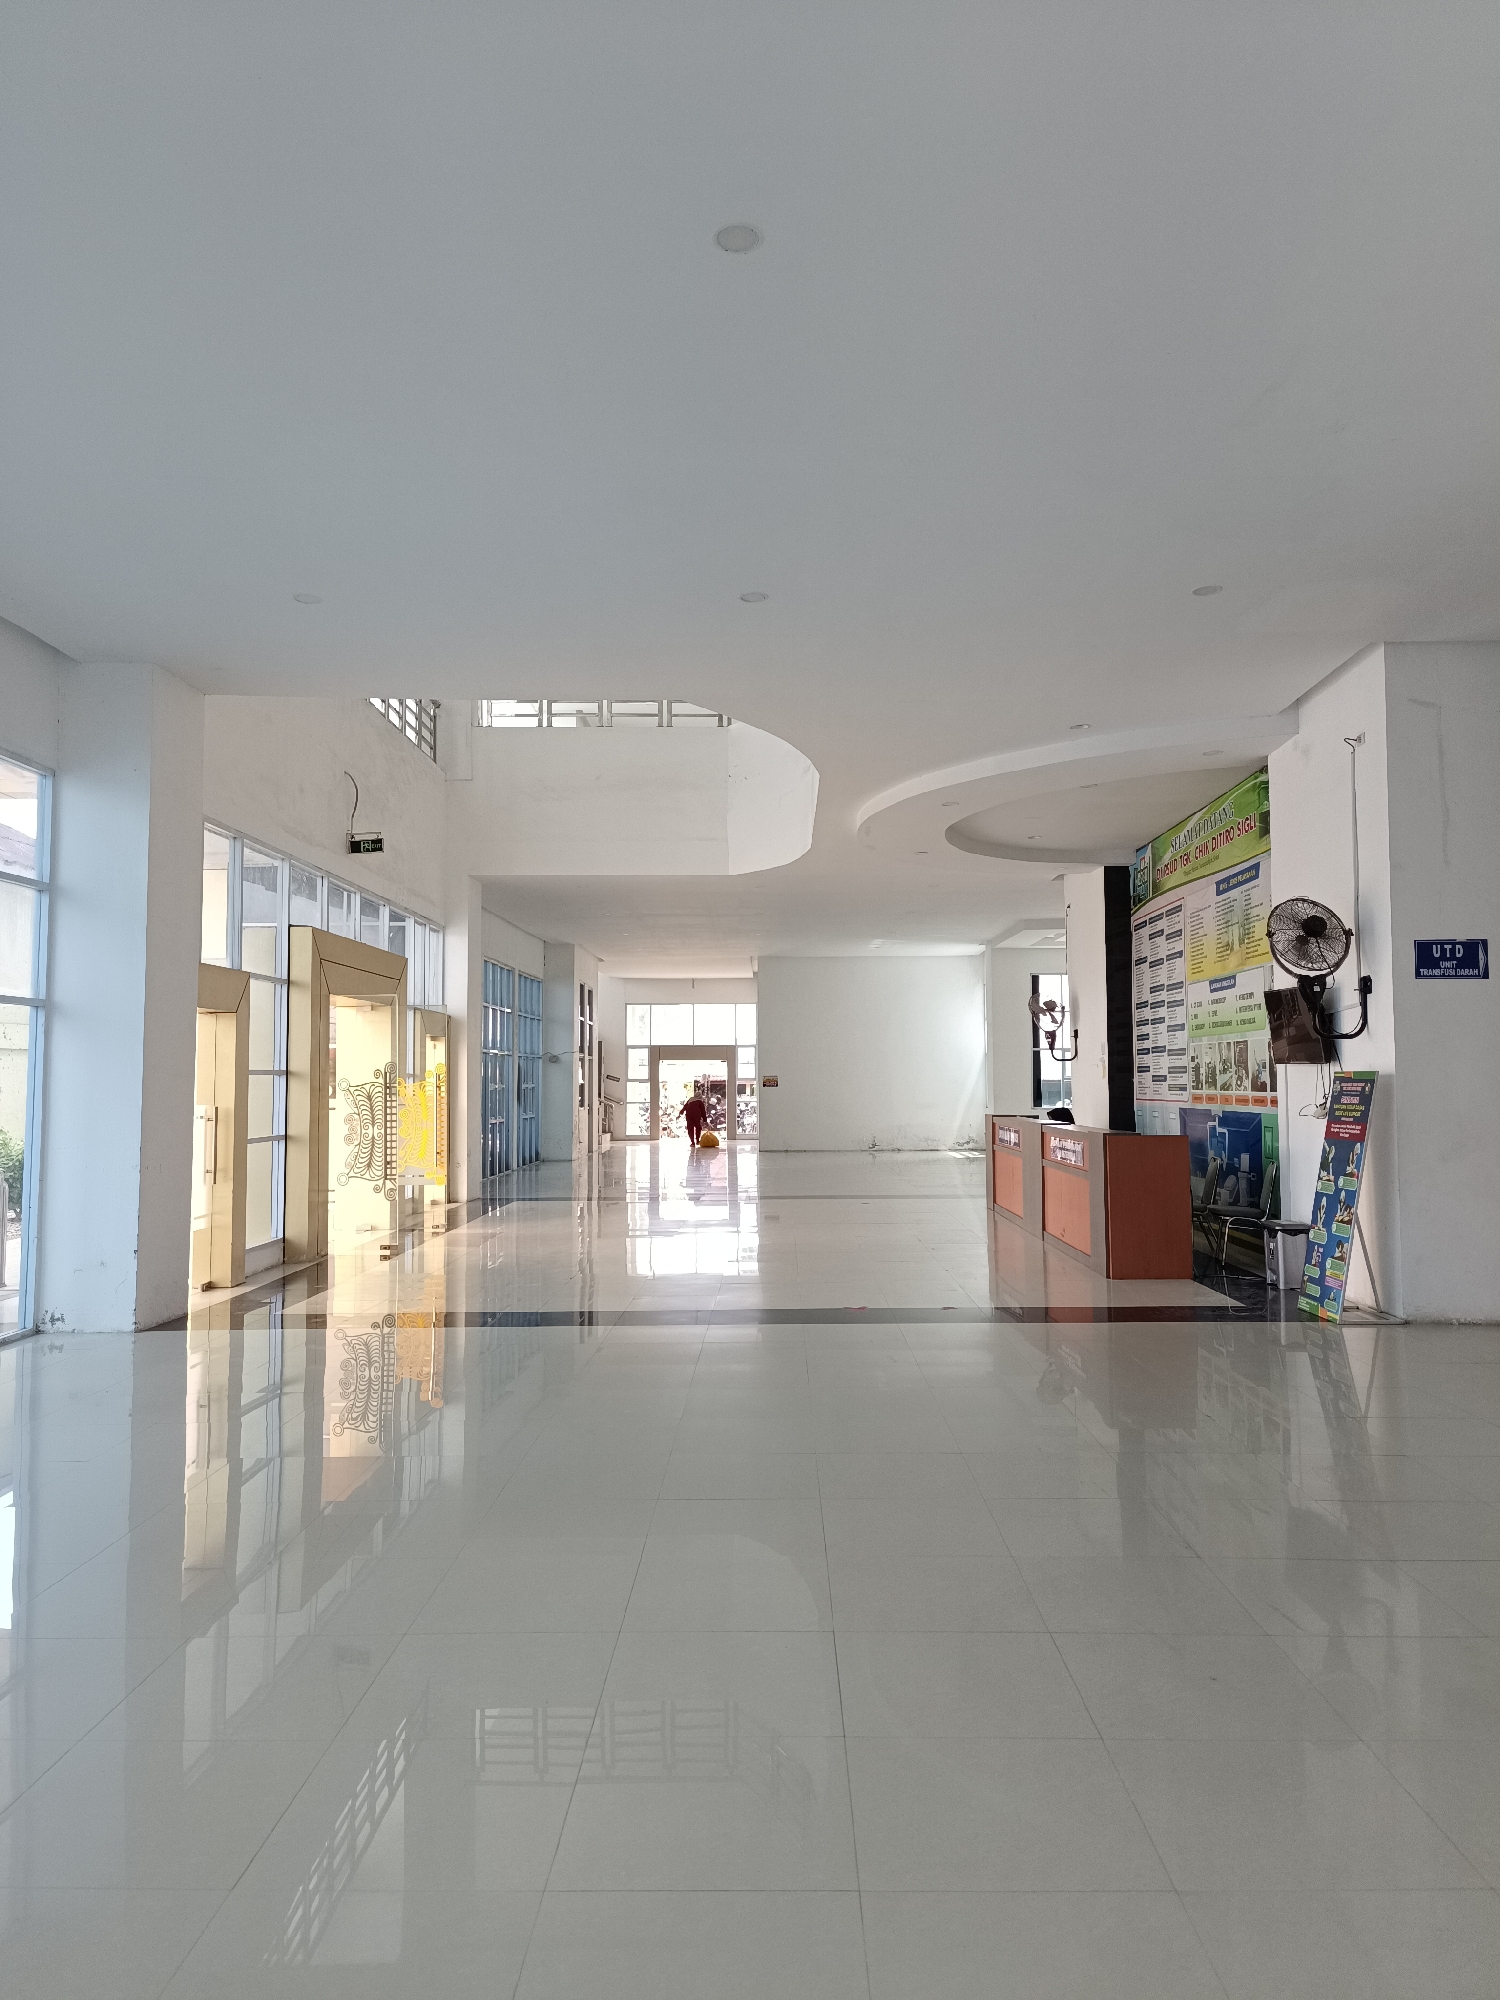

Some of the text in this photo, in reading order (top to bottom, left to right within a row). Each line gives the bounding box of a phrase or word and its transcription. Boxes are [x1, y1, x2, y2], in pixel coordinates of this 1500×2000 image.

[1164, 858, 1178, 877] RSUD
[1194, 840, 1210, 860] CHIK
[1211, 825, 1235, 852] DITIRO
[1237, 812, 1257, 838] SIGLI
[1170, 801, 1234, 853] SELAMAT DATANG
[1420, 968, 1479, 976] TRANSFUSI DARAH
